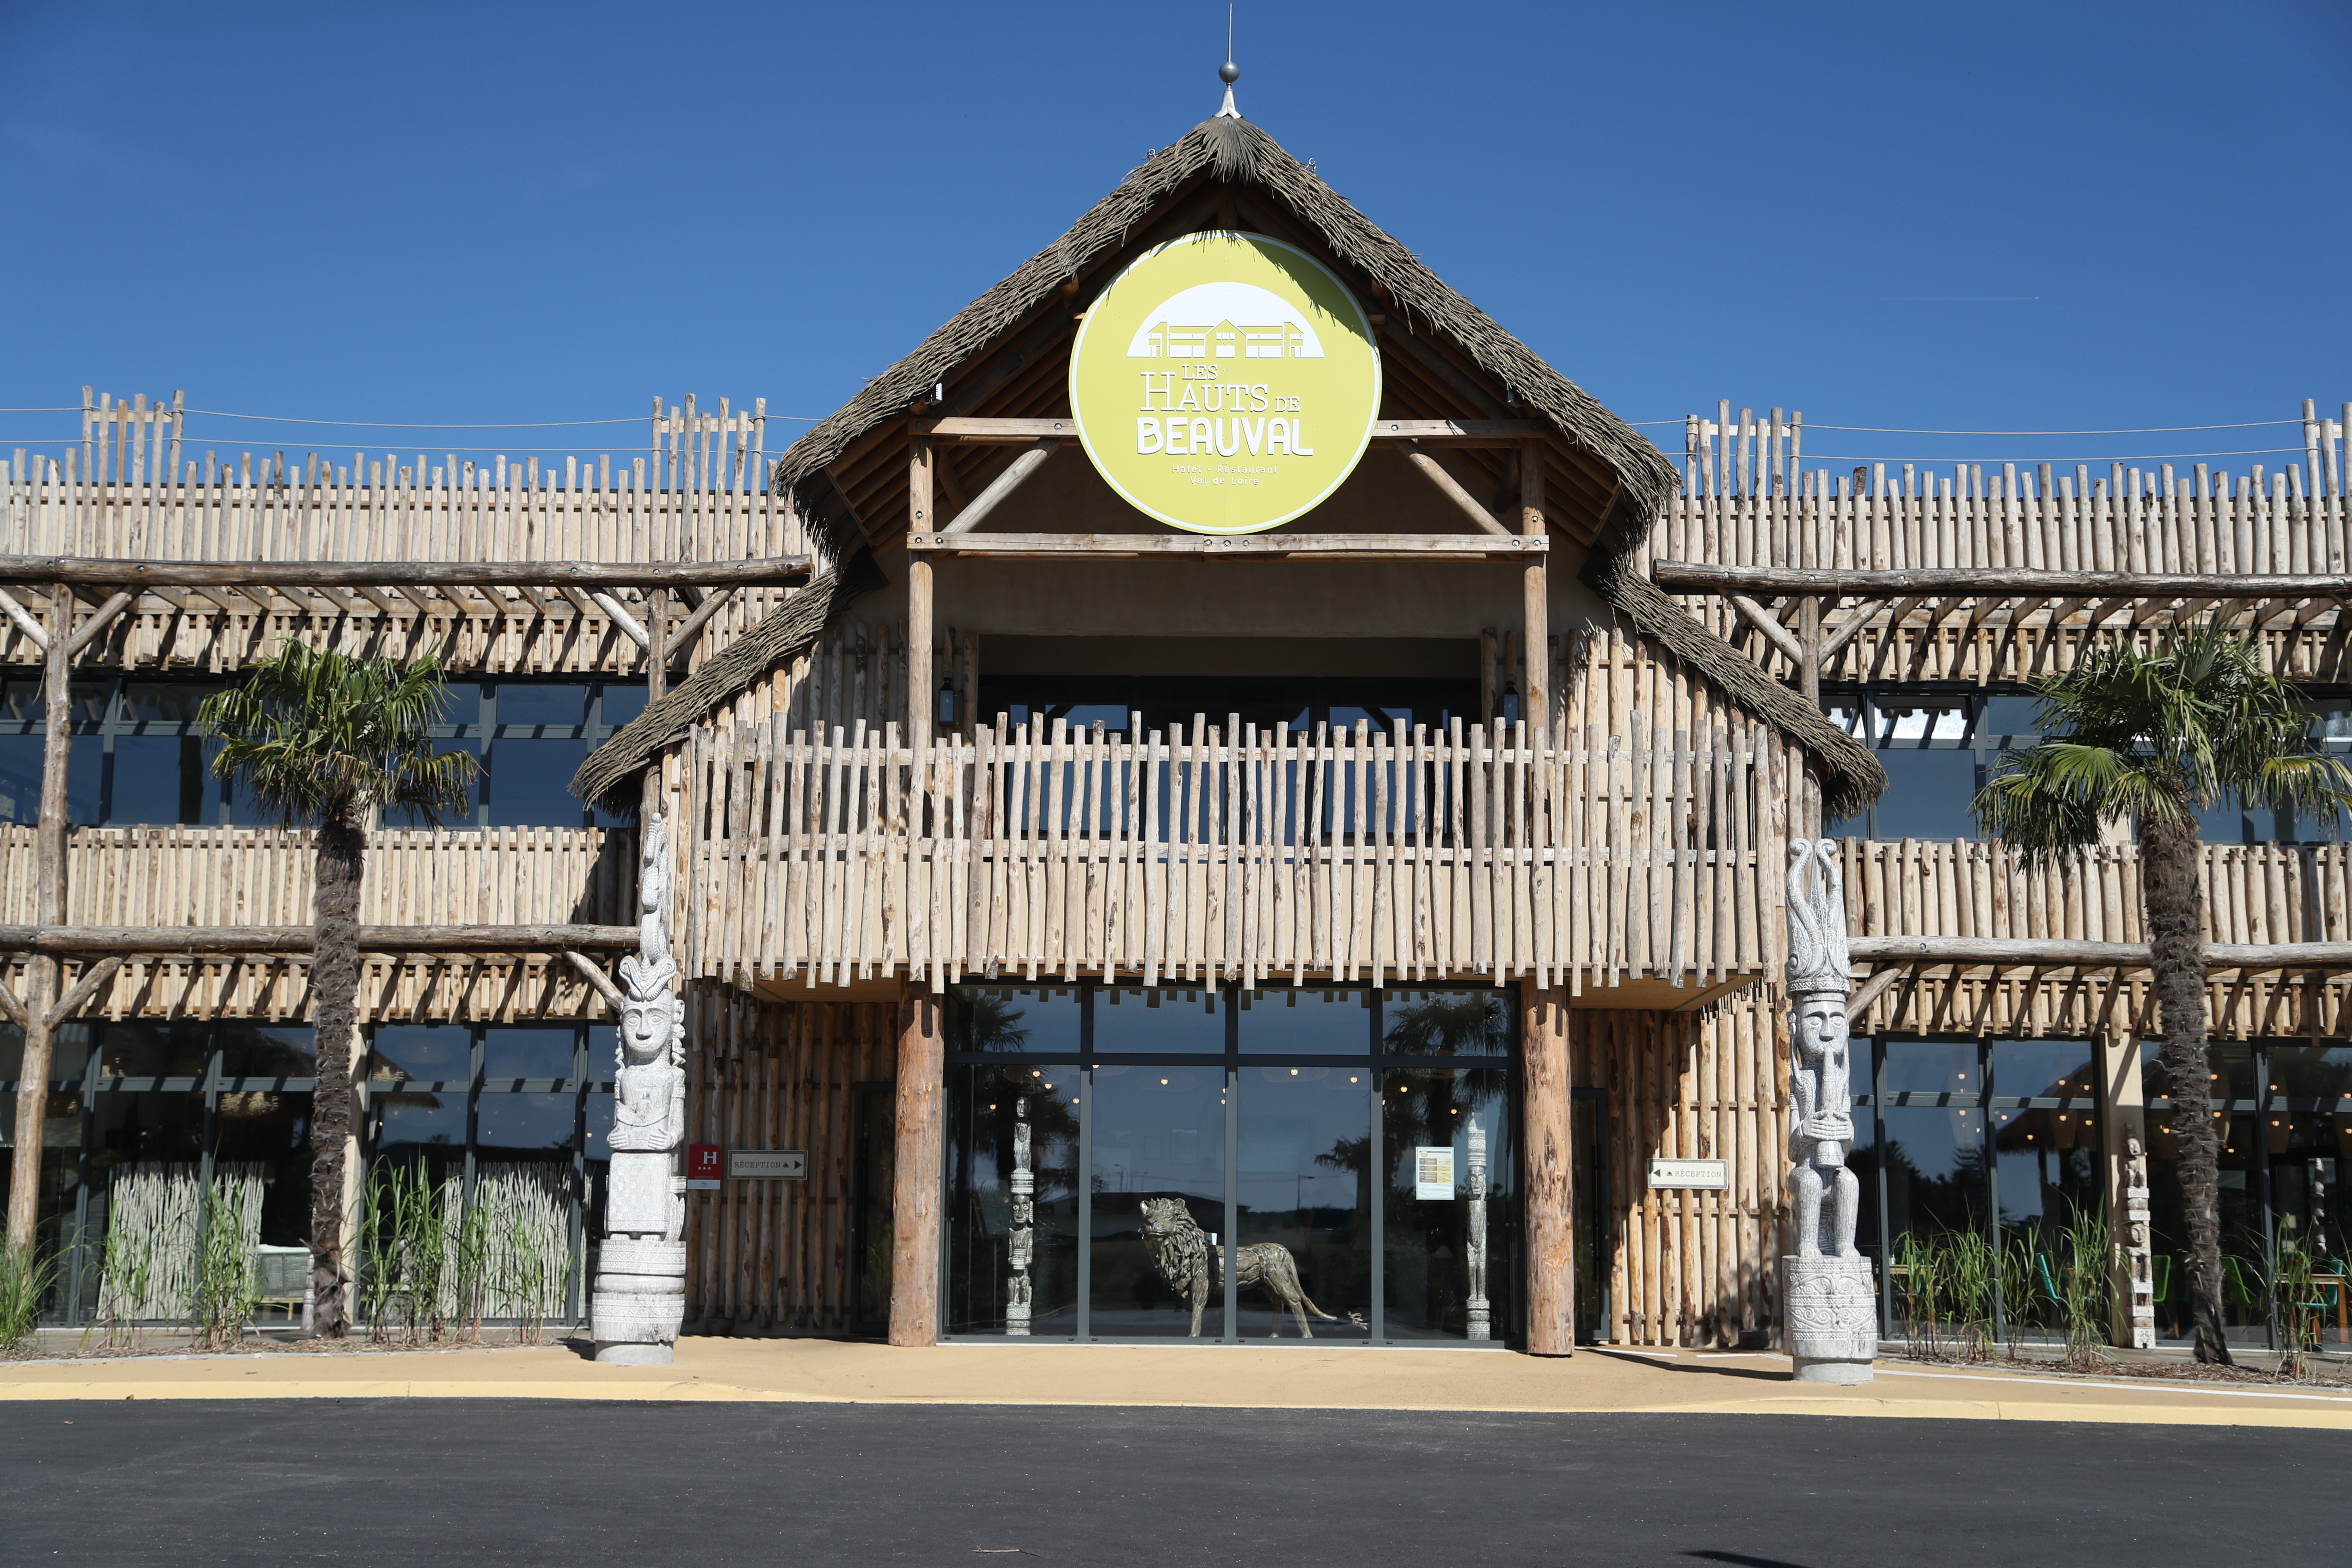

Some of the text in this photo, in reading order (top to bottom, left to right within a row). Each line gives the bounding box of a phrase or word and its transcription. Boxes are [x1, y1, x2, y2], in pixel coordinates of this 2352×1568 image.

[1182, 364, 1219, 380] LES
[1140, 371, 1301, 412] HAUTS DE
[1136, 416, 1314, 457] BEAUVAL
[1172, 465, 1202, 474] Hôtel
[1217, 465, 1278, 474] Restaurant
[1189, 476, 1259, 485] Val de Loire
[702, 1151, 717, 1164] H
[734, 1160, 781, 1169] RÉCEPTION
[1675, 1169, 1722, 1178] RÉCEPTION
